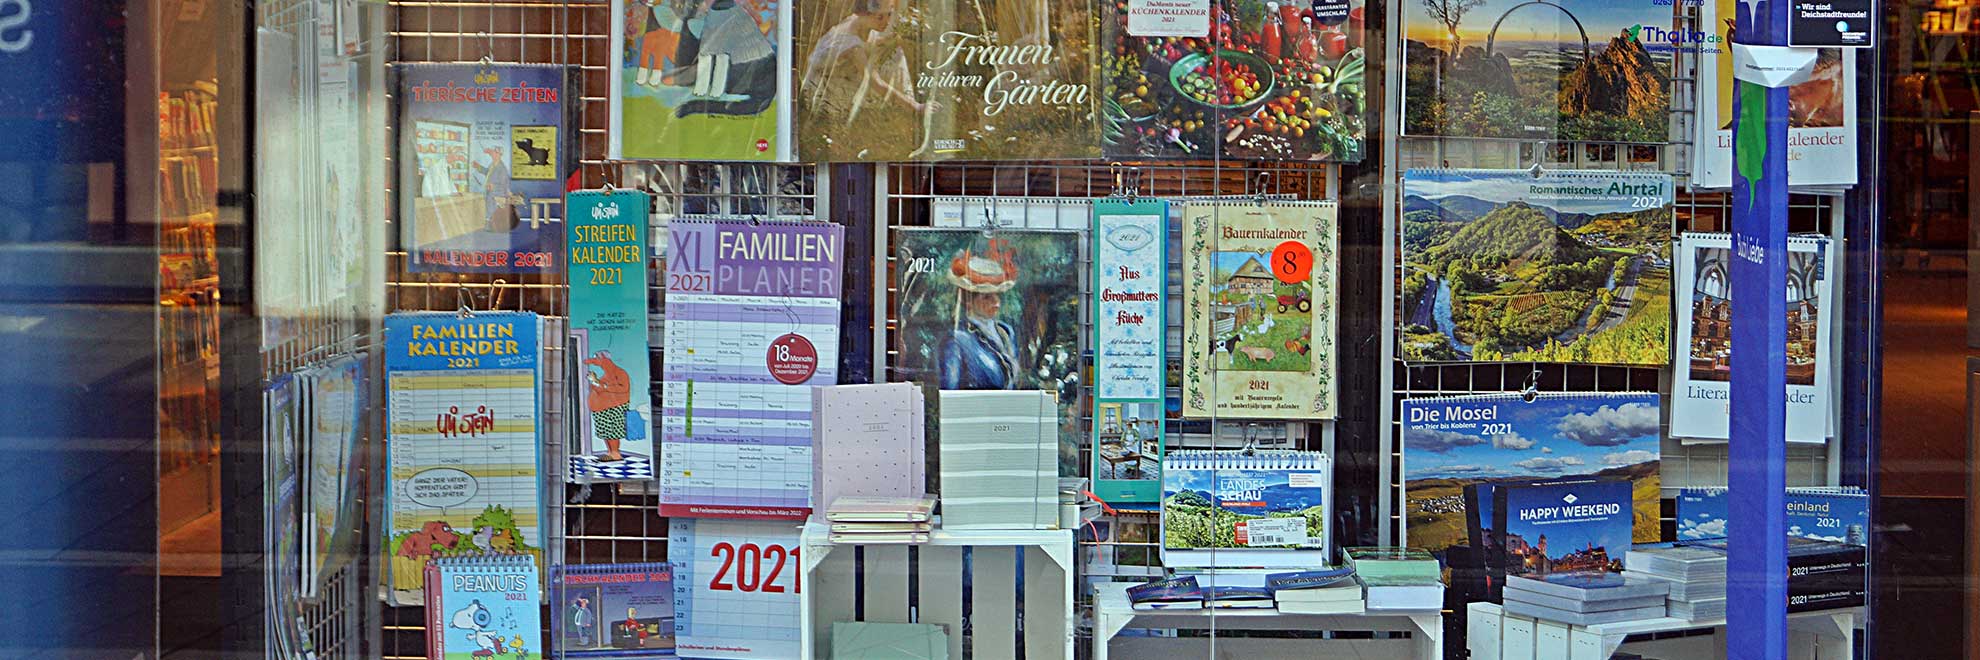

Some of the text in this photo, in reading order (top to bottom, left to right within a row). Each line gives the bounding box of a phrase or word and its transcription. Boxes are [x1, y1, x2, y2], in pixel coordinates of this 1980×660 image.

[1131, 7, 1207, 16] KÜCHENKALENDER
[1316, 9, 1347, 17] UMSCHLAG
[925, 31, 1054, 70] Frauen
[500, 81, 558, 103] ZEITEN
[917, 70, 1088, 116] in ihren Gärten
[1529, 182, 1663, 196] Romantisches Ahrtal
[1632, 196, 1663, 208] 2021
[575, 224, 638, 243] STREIFEN
[1222, 226, 1308, 240] Bauernkalender
[423, 248, 553, 267] KALENDER 2021
[572, 245, 641, 264] KALENDER
[671, 230, 836, 273] XL FAMILIEN
[909, 257, 935, 273] 2021
[1282, 250, 1297, 275] 8
[590, 267, 622, 285] 2021
[670, 265, 834, 295] 2021 PLANER
[1119, 265, 1140, 281] Aus
[412, 323, 513, 340] FAMILIEN
[408, 340, 519, 357] KALENDER
[774, 344, 789, 361] 18
[447, 357, 480, 369] 2021
[1248, 379, 1269, 391] 2021
[1410, 405, 1497, 422] Die Mosel
[1481, 423, 1512, 435] 2021
[1220, 479, 1267, 491] LANDES
[1220, 490, 1262, 501] SCHAU
[1520, 507, 1559, 521] HAPPY
[1562, 503, 1620, 518] WEEKEND
[1786, 501, 1830, 513] einland
[1816, 517, 1840, 528] 2021
[709, 541, 801, 595] 2021
[1792, 566, 1809, 576] 2021
[452, 573, 528, 592] PEANUTS
[1791, 595, 1808, 605] 2021
